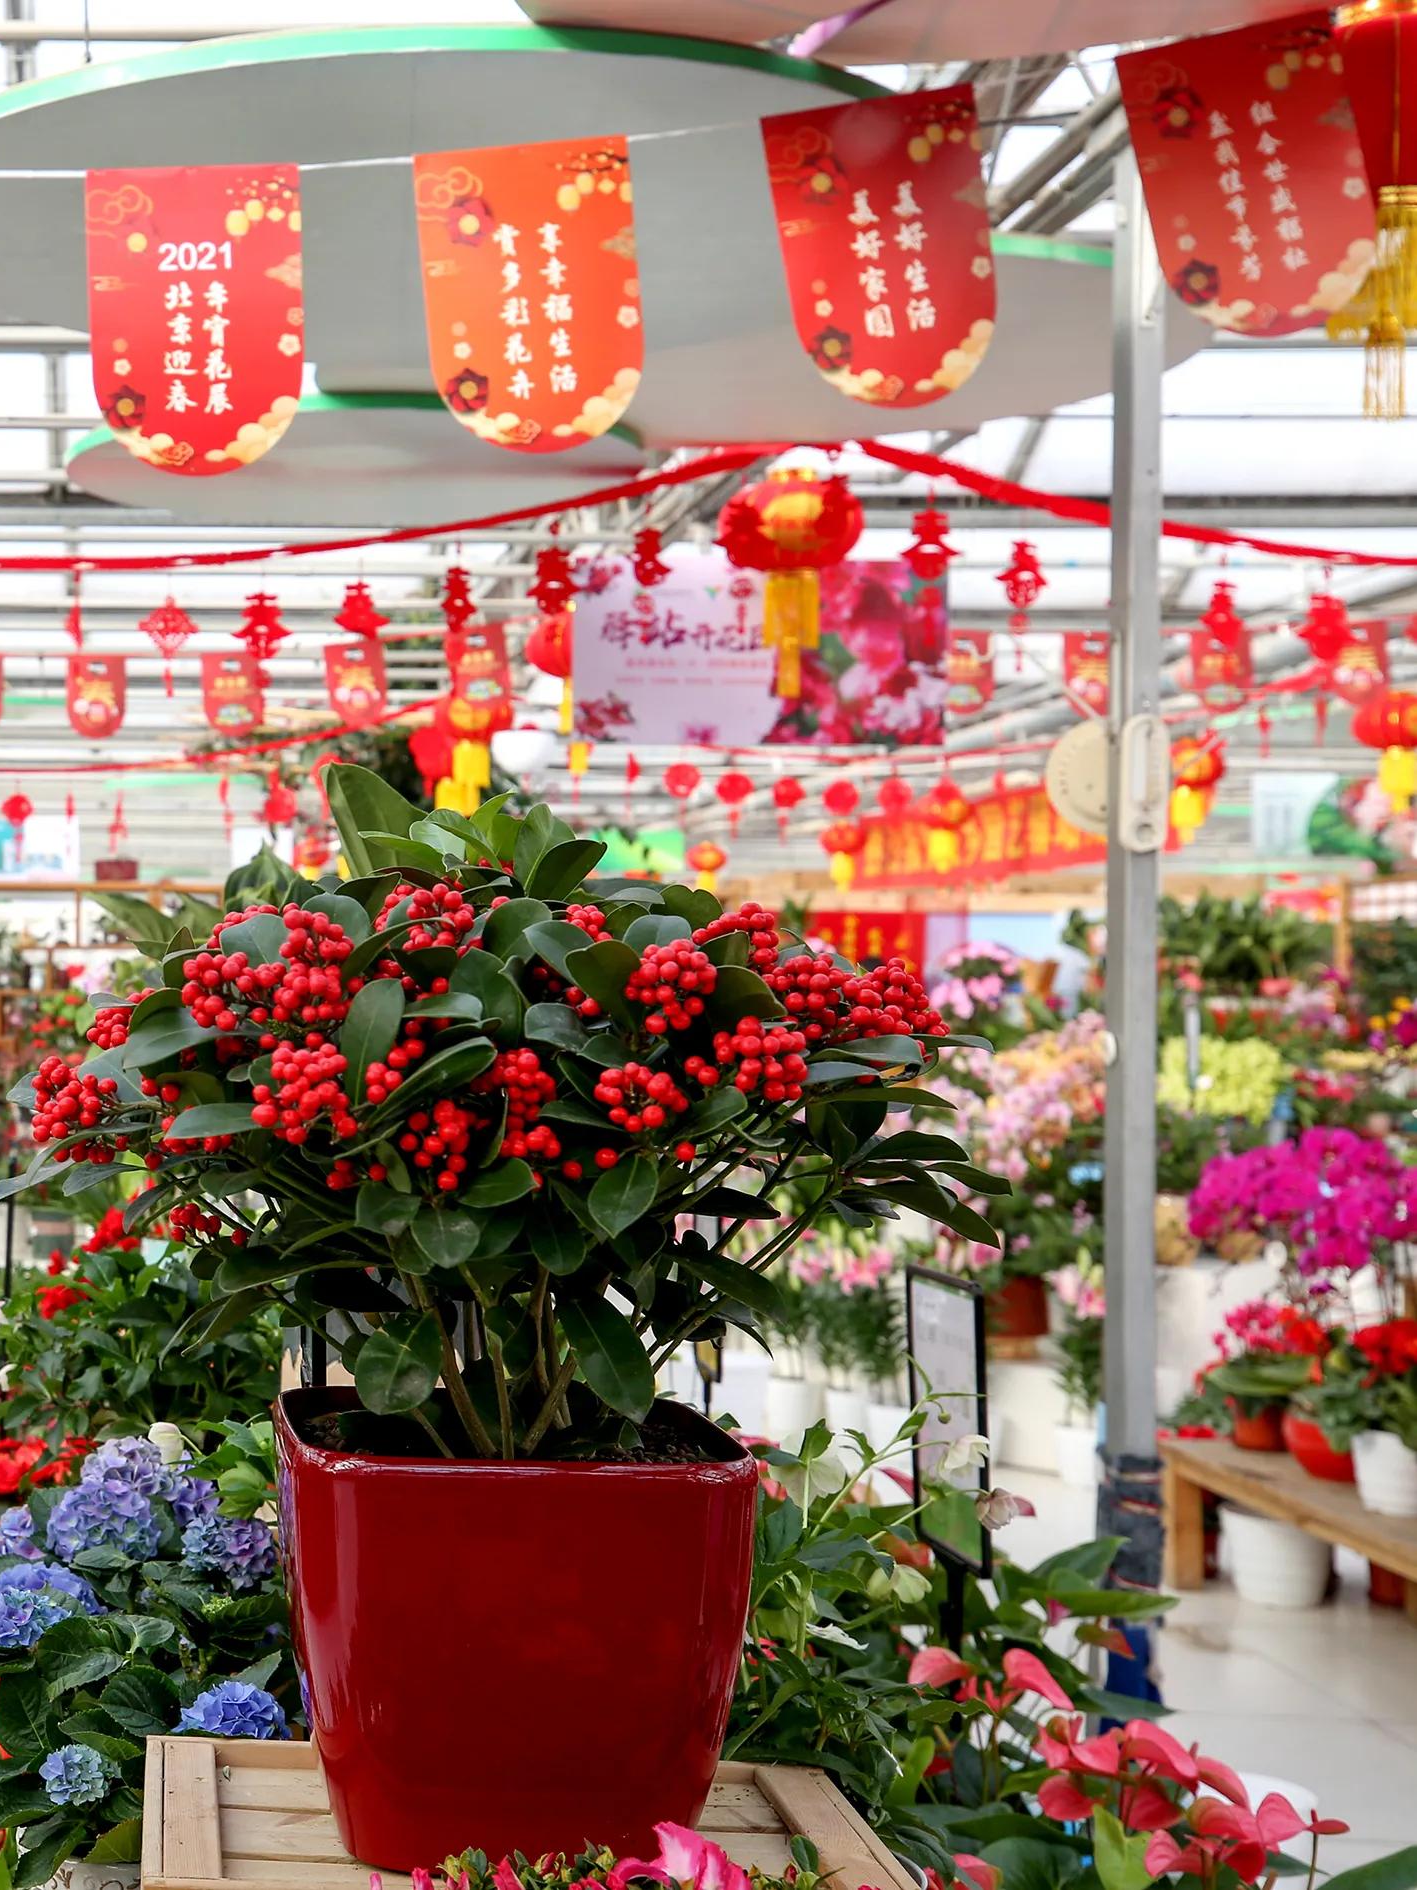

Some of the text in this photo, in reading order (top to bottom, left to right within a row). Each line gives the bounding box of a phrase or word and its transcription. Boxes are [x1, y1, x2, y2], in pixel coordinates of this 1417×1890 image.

[157, 240, 232, 272] 2021
[492, 223, 535, 400] 赏多彩花卉
[537, 222, 577, 394] 享幸福生活
[848, 189, 895, 338] 美好家园
[892, 180, 936, 331] 美好生活
[164, 280, 198, 413] 北京迎春
[202, 280, 233, 415] 年宵花展
